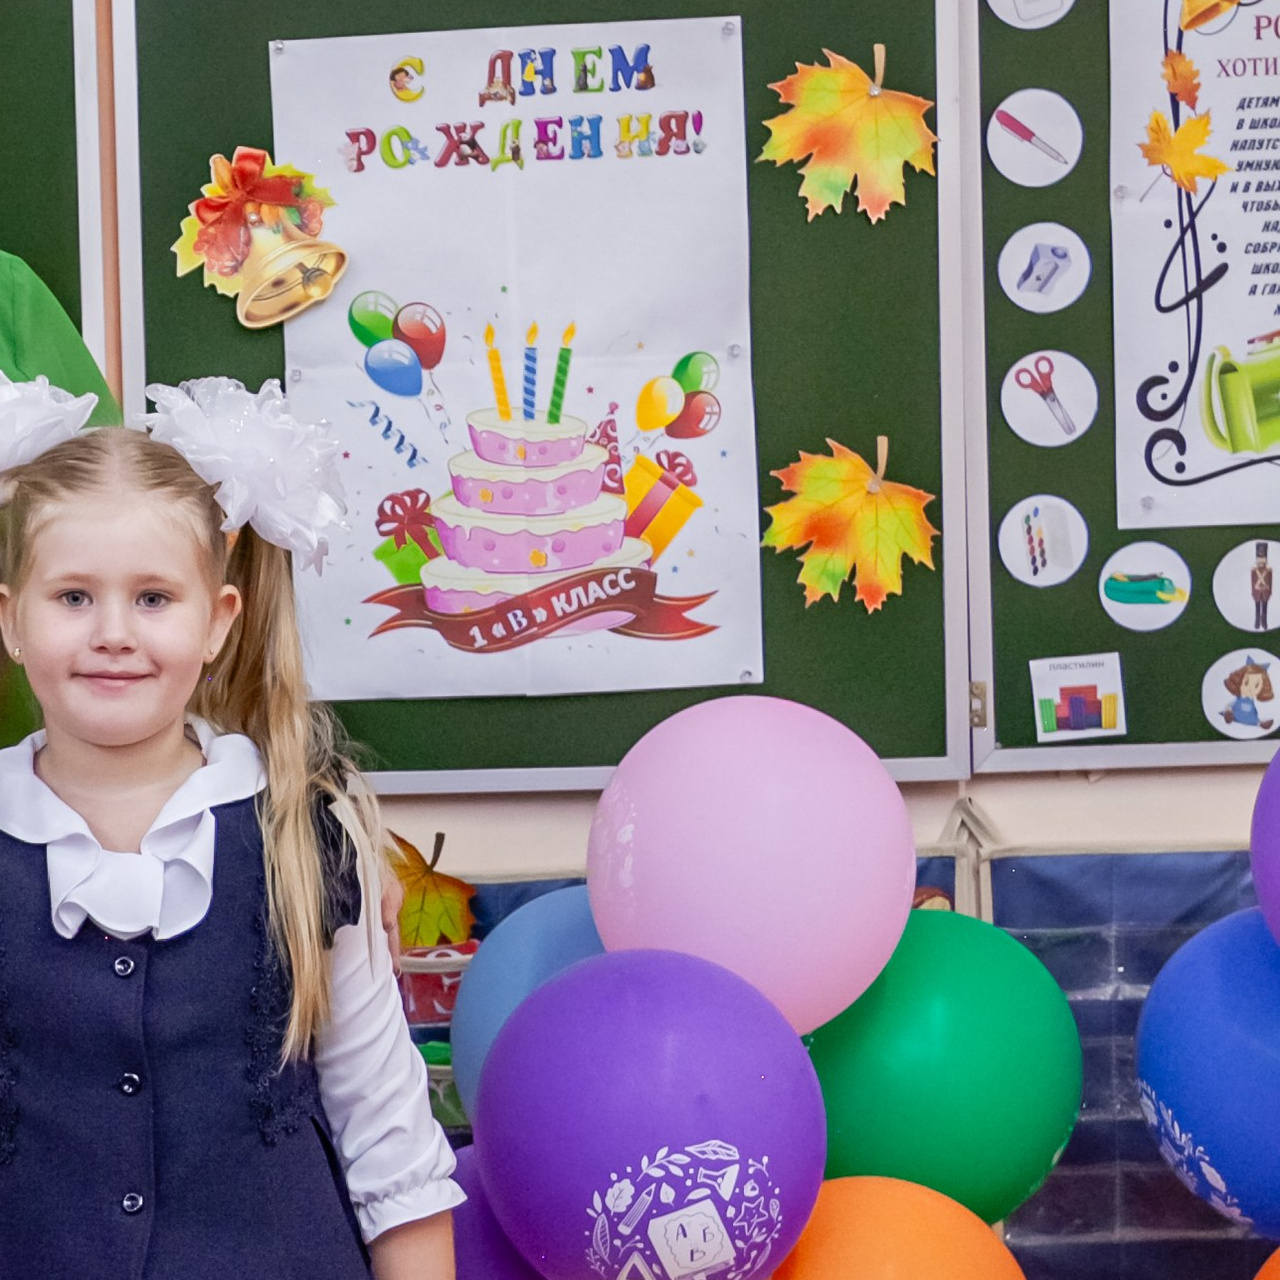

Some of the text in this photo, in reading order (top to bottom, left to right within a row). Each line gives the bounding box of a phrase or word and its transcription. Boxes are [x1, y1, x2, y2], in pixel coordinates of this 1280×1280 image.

[389, 43, 655, 108] С ДНЕМ
[341, 109, 708, 172] РОЖДЕНИЯ!
[470, 625, 488, 649] 1
[550, 568, 636, 617] КЛАСС
